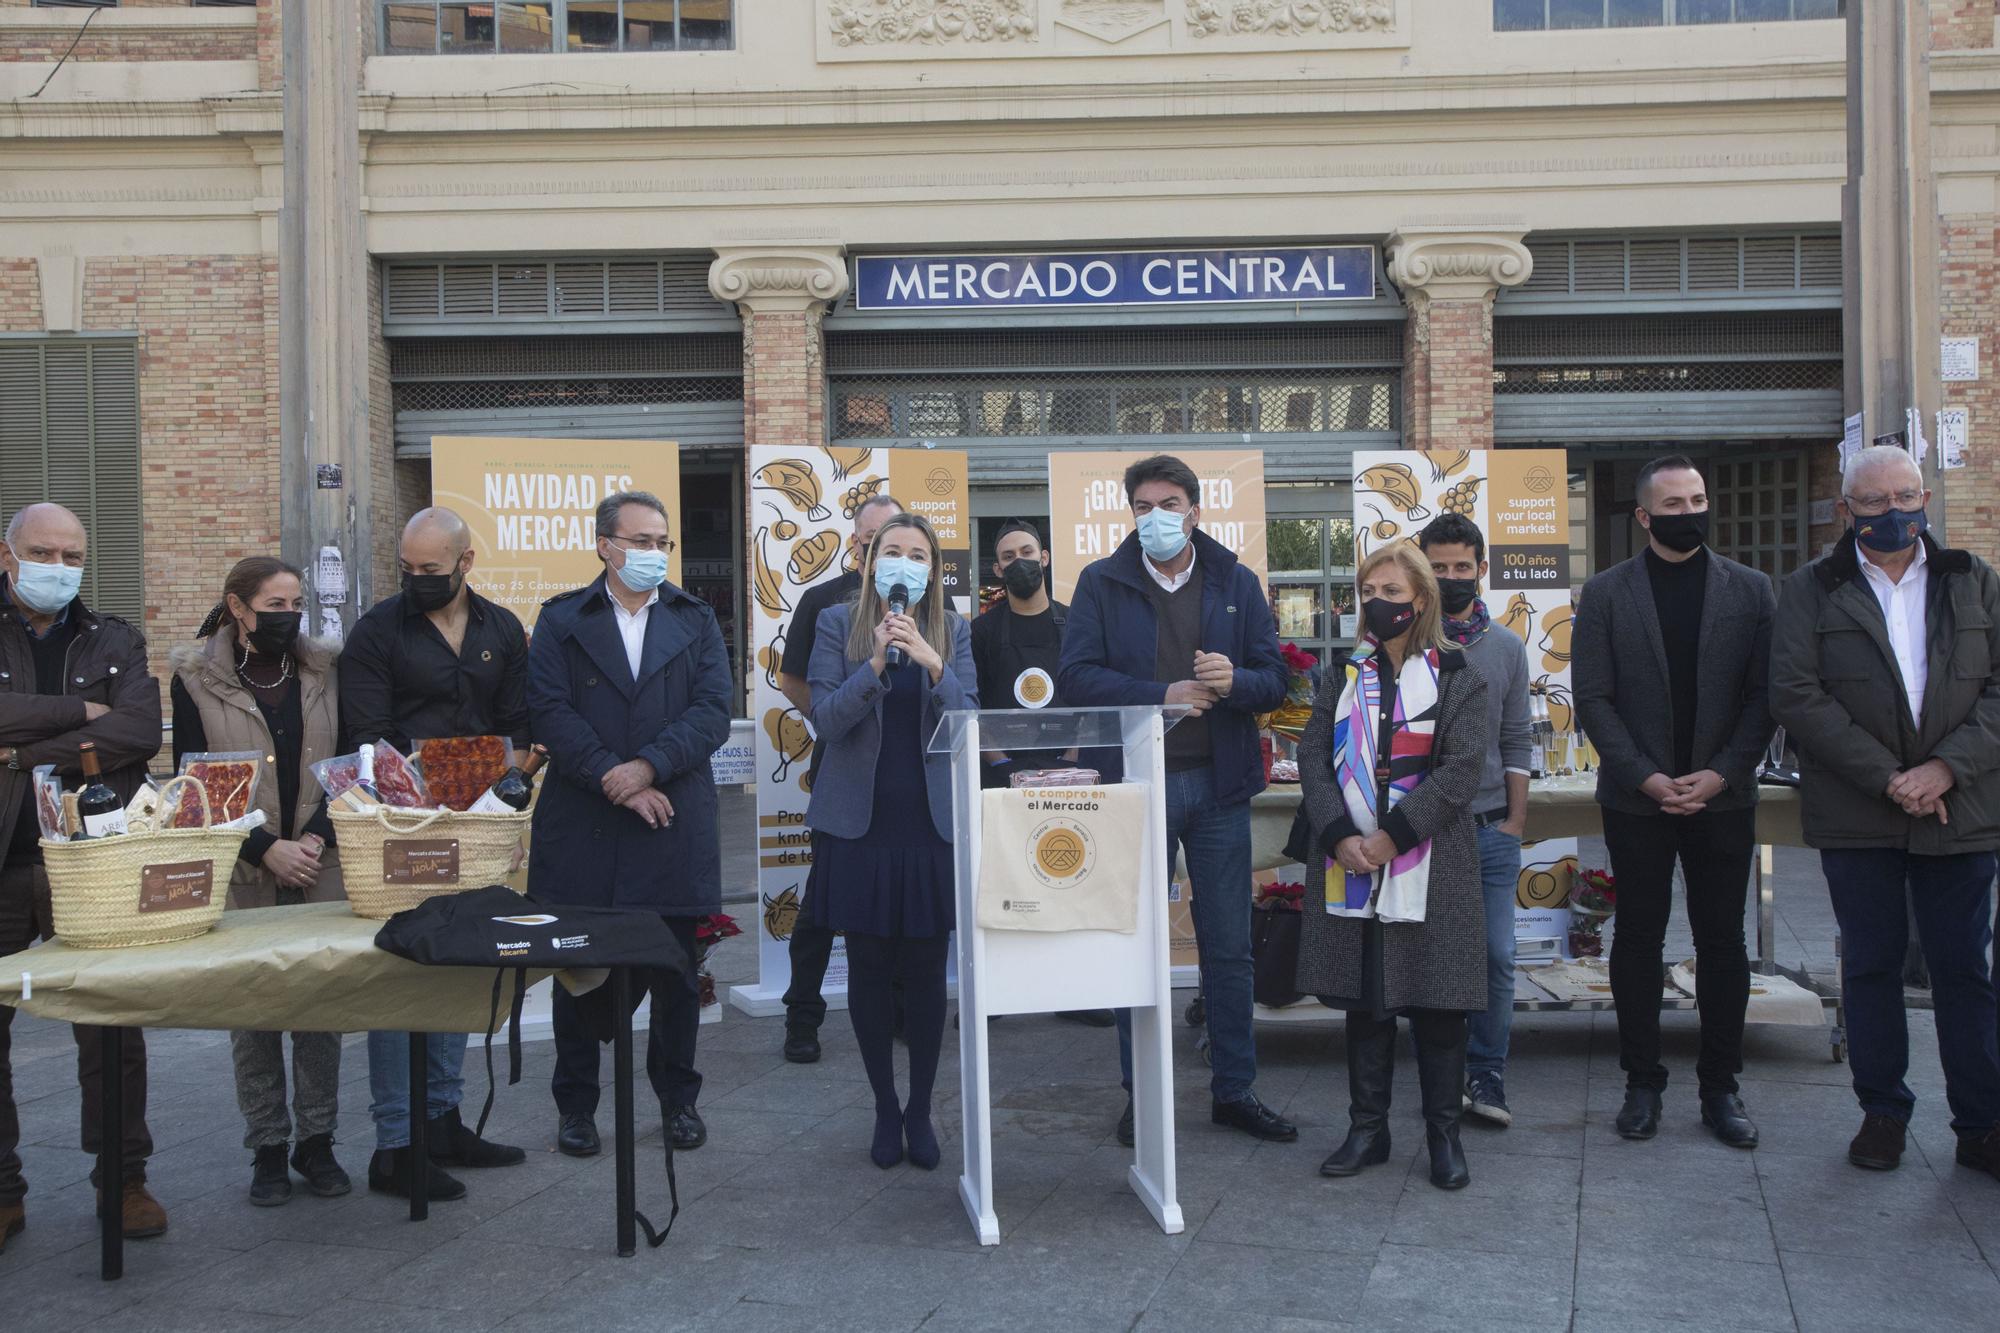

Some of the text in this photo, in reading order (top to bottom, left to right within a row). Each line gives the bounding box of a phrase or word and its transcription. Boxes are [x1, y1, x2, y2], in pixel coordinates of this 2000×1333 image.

[886, 255, 1346, 300] MERCADO CENTRAL
[484, 472, 597, 510] NAVIDAD
[1084, 478, 1233, 518] ¡GRA TEO
[1508, 496, 1556, 509] support
[910, 499, 957, 512] support
[929, 514, 957, 525] local
[1497, 510, 1556, 523] your local
[497, 515, 597, 551] MERCAD
[1506, 523, 1557, 534] markets
[1074, 523, 1101, 555] EN
[1503, 553, 1557, 566] 100 años
[1503, 568, 1557, 579] a tu lado
[510, 581, 524, 591] 25
[1022, 789, 1106, 800] Yo compro en
[1028, 801, 1099, 811] el Mercado
[1033, 825, 1049, 840] Central
[778, 851, 796, 864] de
[412, 859, 438, 876] MOLA
[168, 881, 193, 901] MOLA
[497, 941, 531, 950] Mercados
[499, 949, 529, 957] Alicante
